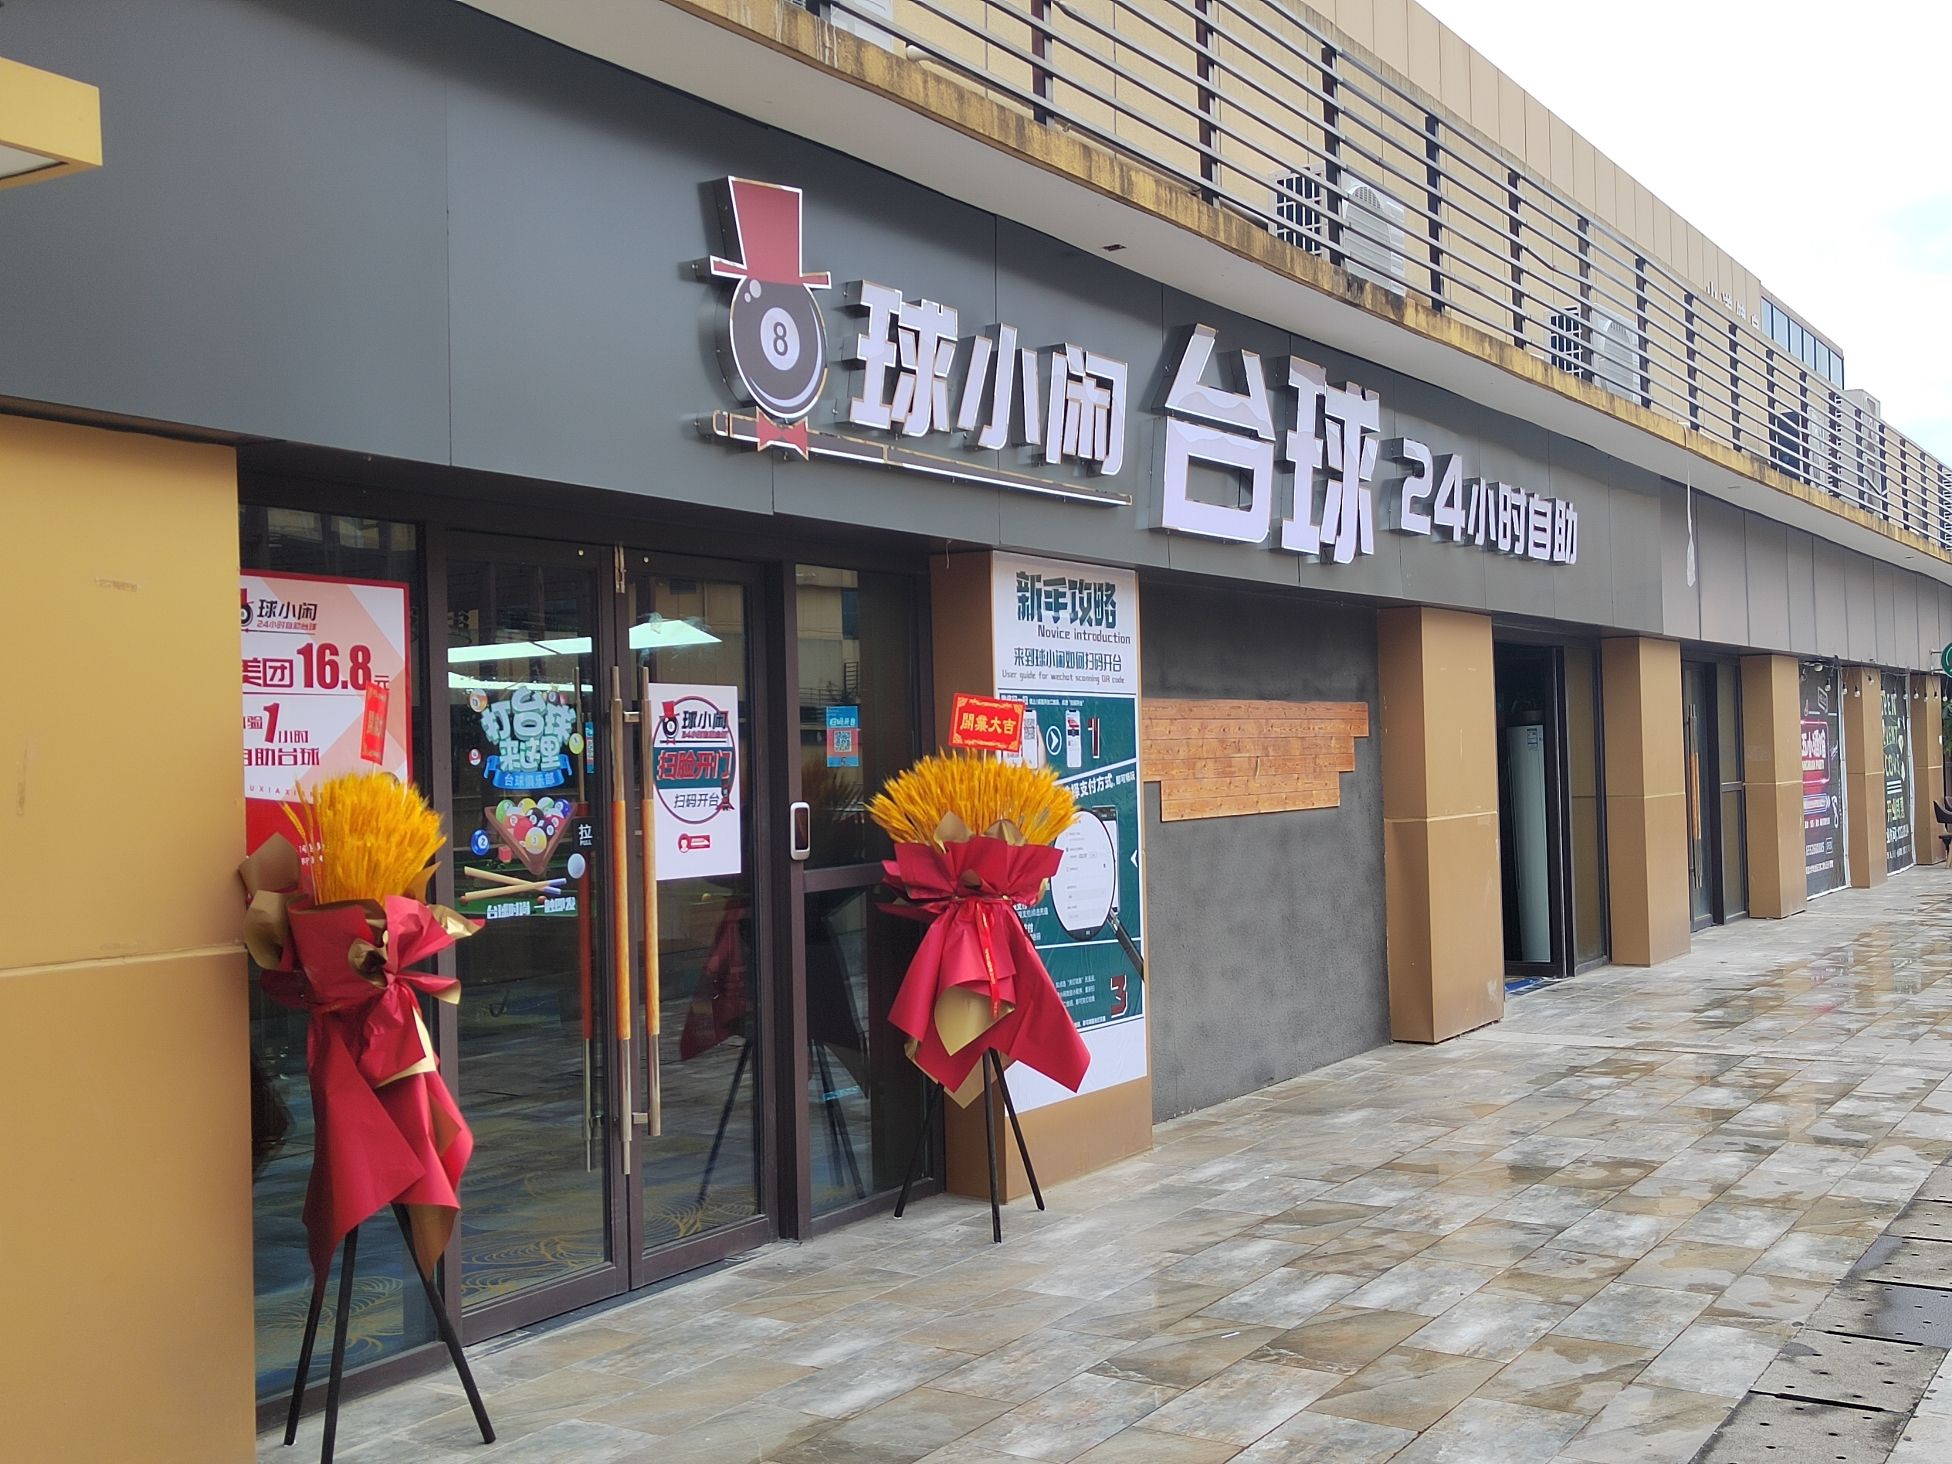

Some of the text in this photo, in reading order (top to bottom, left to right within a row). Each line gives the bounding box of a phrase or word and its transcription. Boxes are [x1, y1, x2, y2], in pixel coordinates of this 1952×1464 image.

[1161, 323, 1381, 564] 台球
[1400, 436, 1578, 566] 24小时自助
[1015, 570, 1118, 630] 新手攻略
[1037, 625, 1131, 645] Novice introduction
[296, 642, 373, 691] 16.8
[1001, 669, 1016, 678] User
[1019, 670, 1036, 681] guide
[1038, 671, 1049, 680] for
[1050, 672, 1073, 681] wechat
[242, 702, 309, 744] 验 1 小时
[481, 686, 576, 746] 打台球
[960, 712, 1017, 735] 開業大吉
[499, 737, 560, 772] 来这里
[656, 749, 733, 780] 扫脸开门
[673, 793, 720, 809] 扫码开台
[577, 823, 593, 840] 拉
